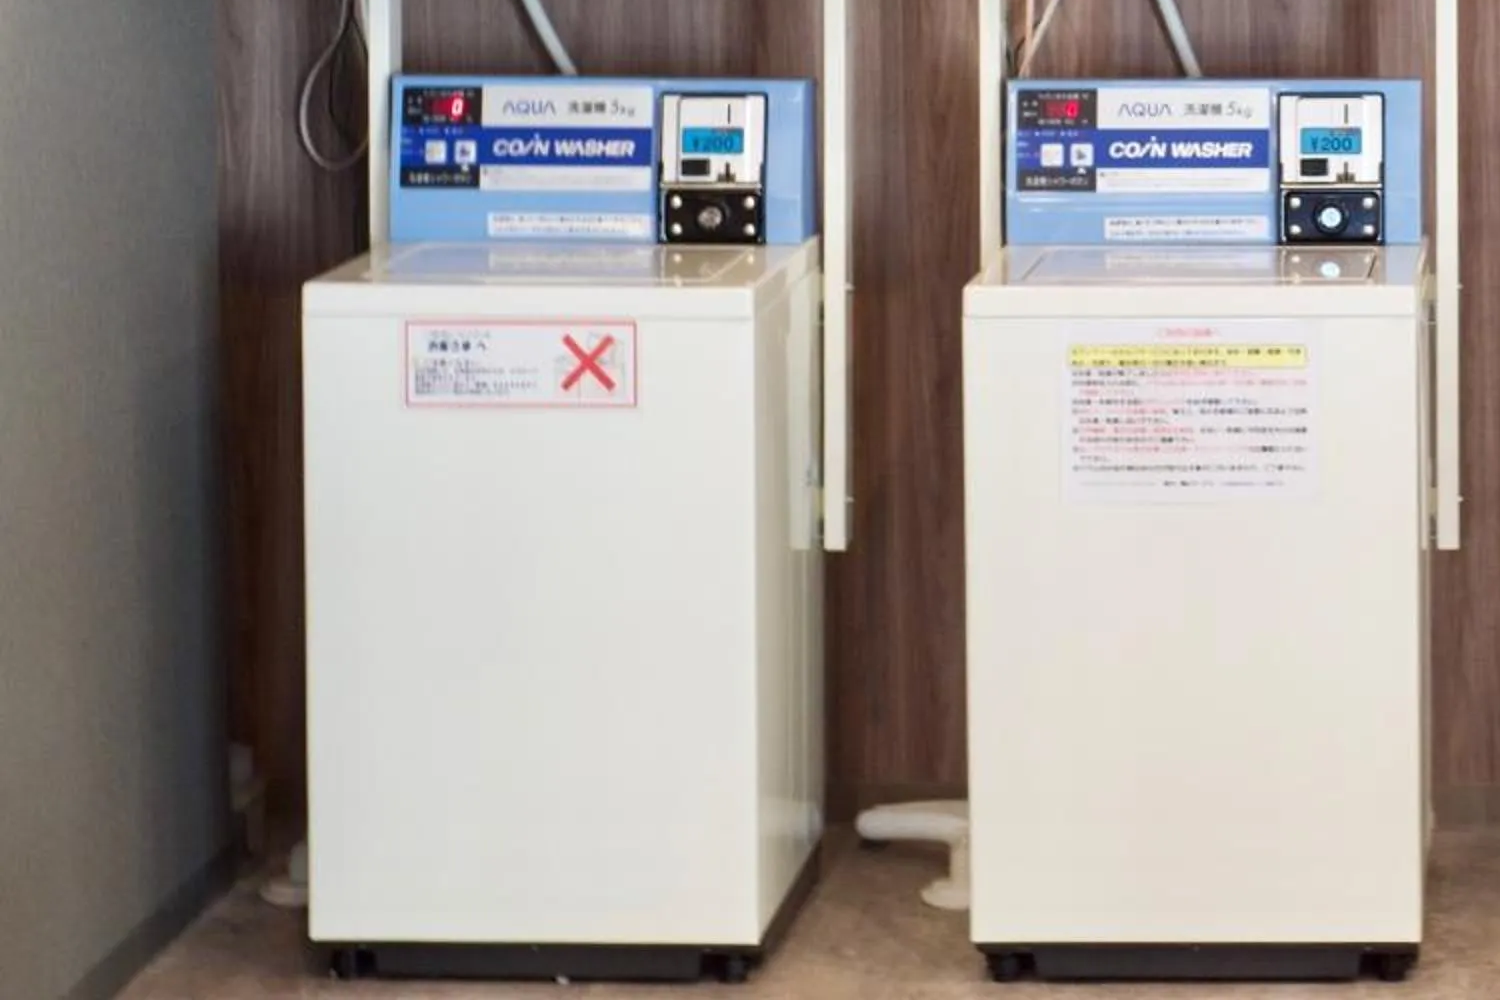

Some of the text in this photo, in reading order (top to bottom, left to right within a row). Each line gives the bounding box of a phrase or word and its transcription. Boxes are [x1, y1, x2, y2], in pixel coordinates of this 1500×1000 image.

[502, 100, 557, 115] AQUA
[1117, 103, 1172, 118] AQUA
[554, 139, 636, 157] WASHER
[1171, 141, 1253, 158] WASHER
